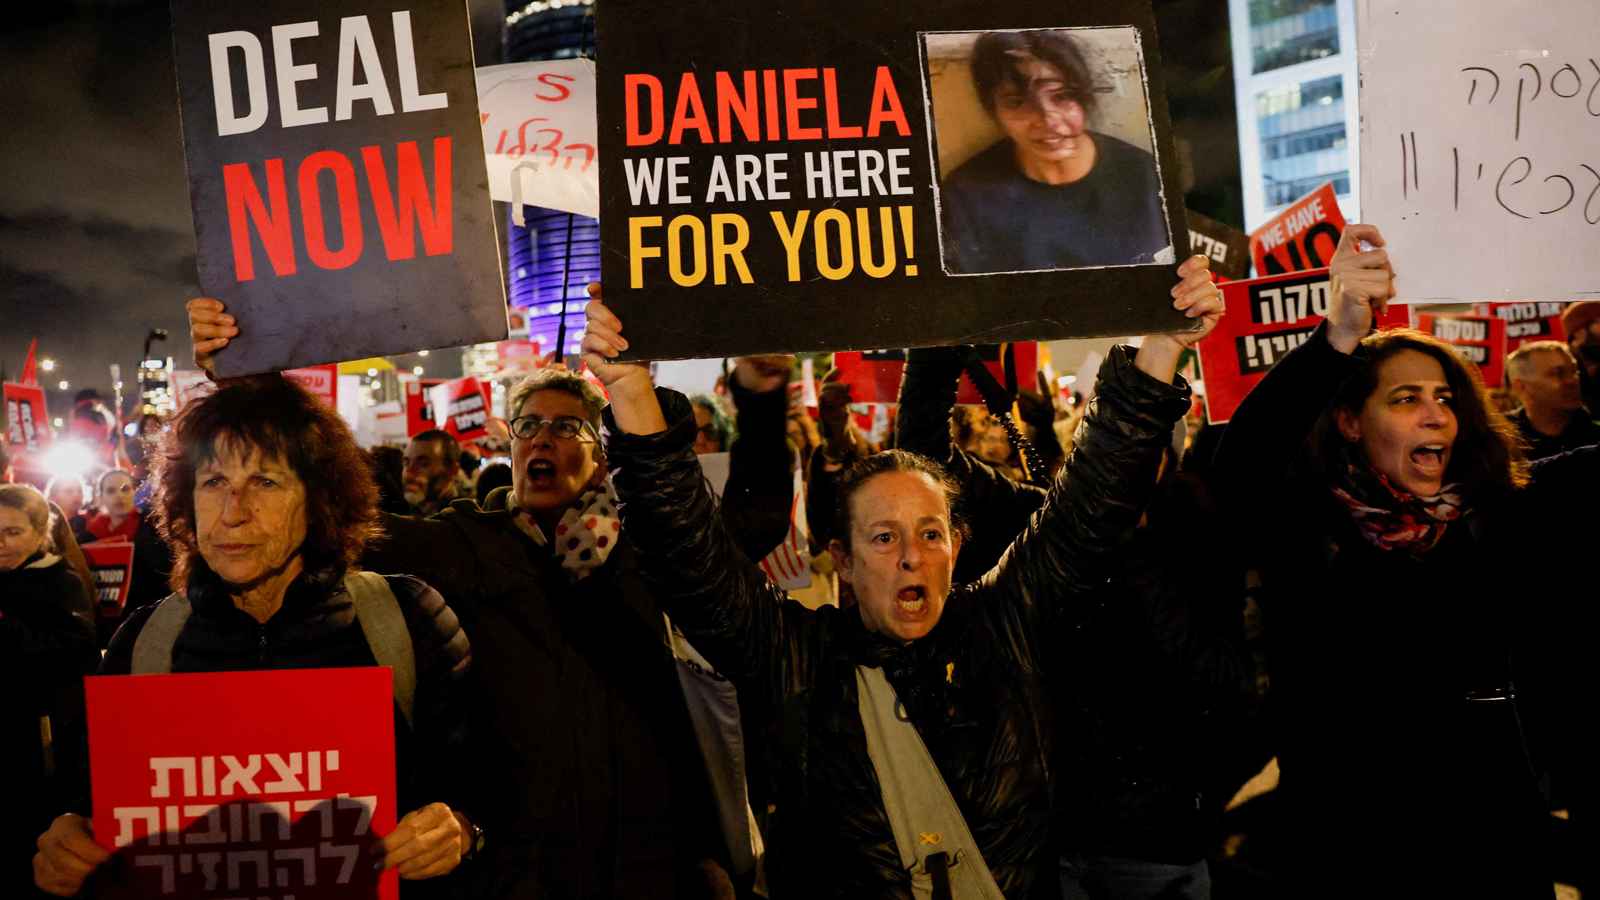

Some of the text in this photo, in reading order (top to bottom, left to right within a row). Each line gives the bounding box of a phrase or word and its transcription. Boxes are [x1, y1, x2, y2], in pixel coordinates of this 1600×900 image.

[208, 10, 449, 136] DEAL
[624, 66, 912, 146] DANIELA
[624, 148, 914, 206] WE ARE HERE
[223, 136, 452, 282] NOW
[1259, 198, 1327, 251] WE HAVE
[628, 205, 918, 289] FOR YOU!
[1258, 284, 1330, 325] סקה
[149, 750, 339, 798] יוצאות
[113, 793, 378, 848] לרחובות
[135, 844, 361, 894] להחזיר
